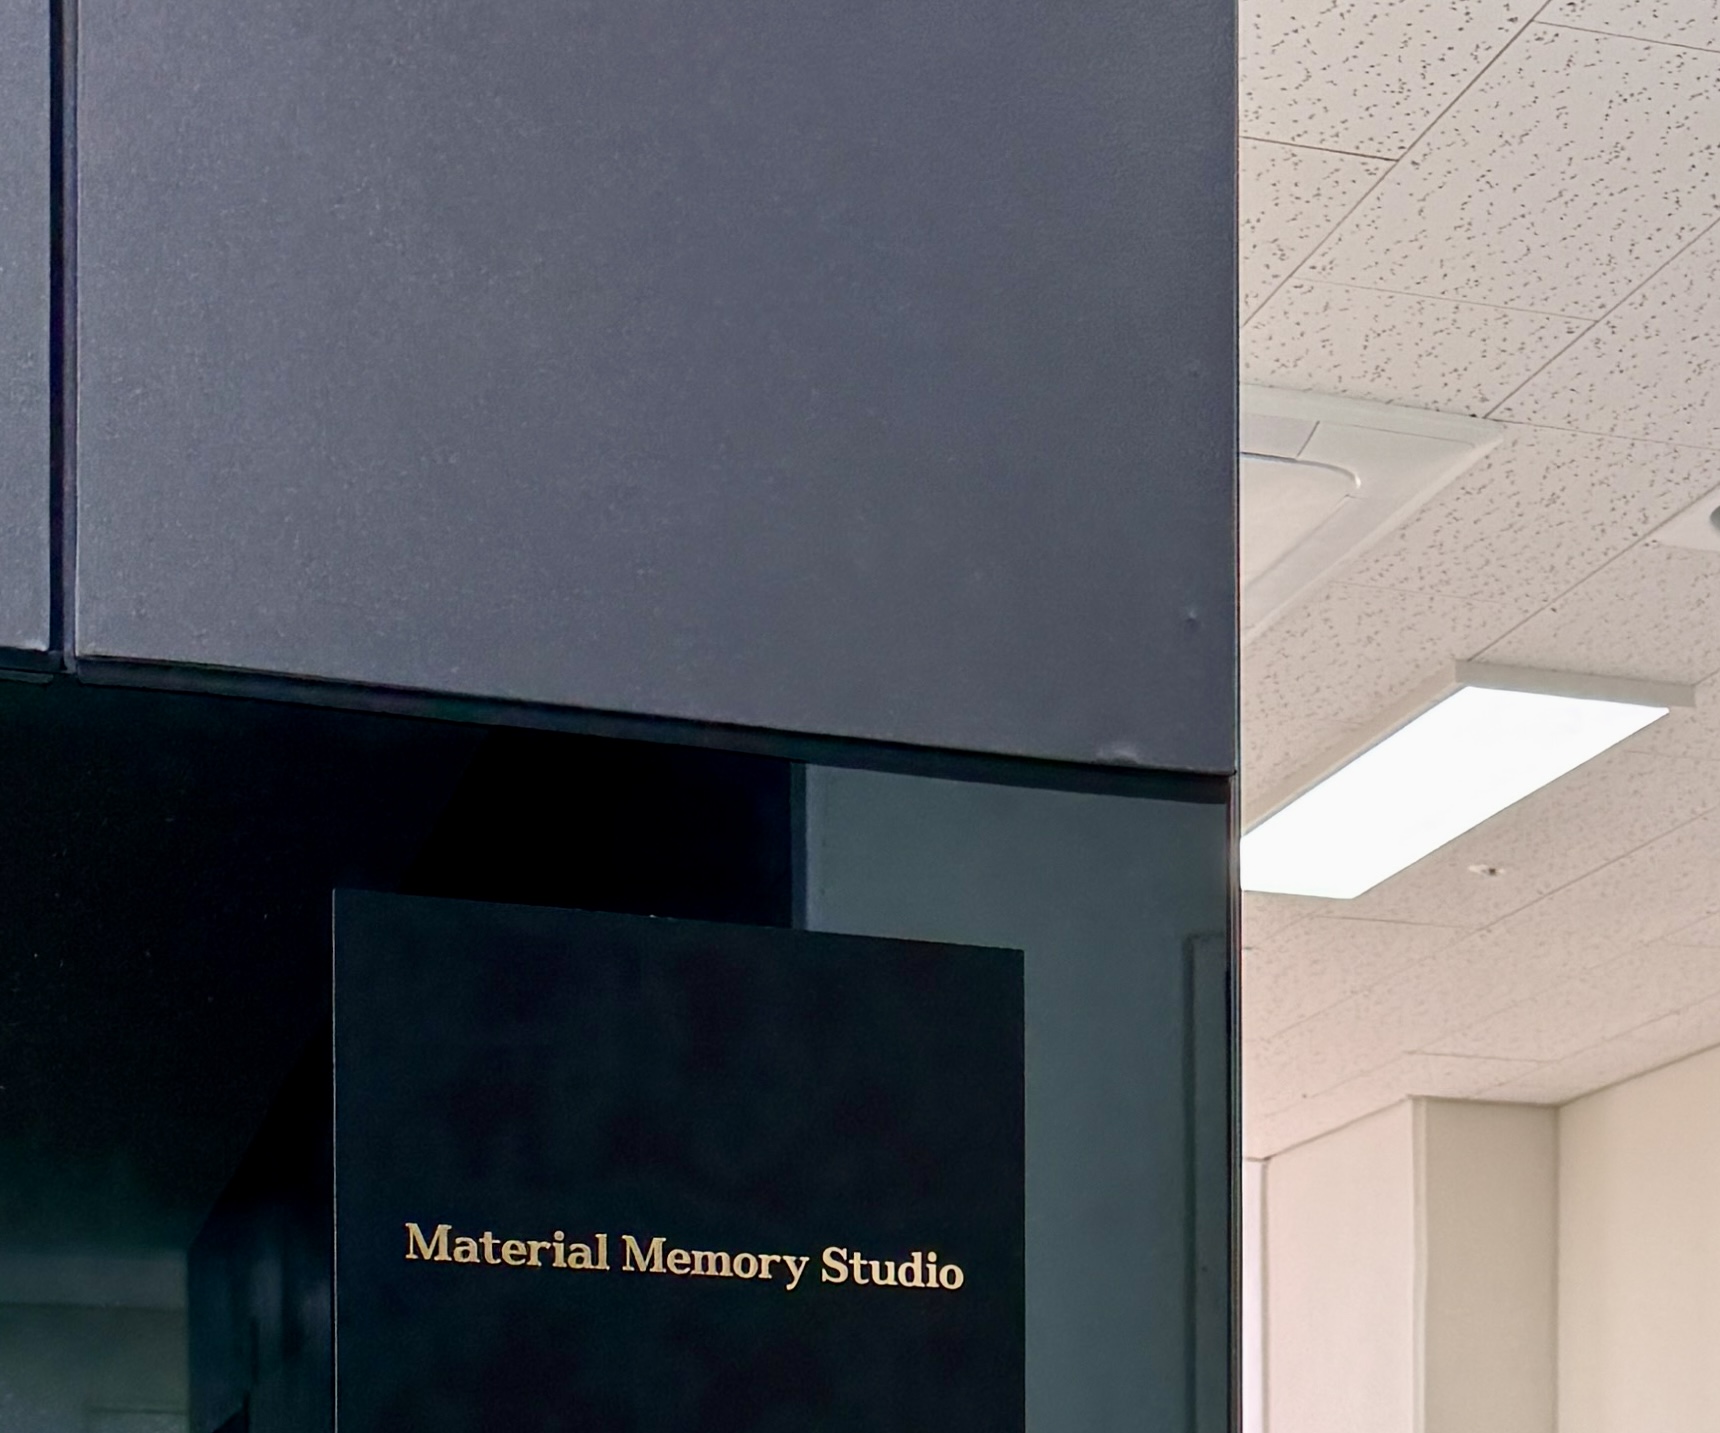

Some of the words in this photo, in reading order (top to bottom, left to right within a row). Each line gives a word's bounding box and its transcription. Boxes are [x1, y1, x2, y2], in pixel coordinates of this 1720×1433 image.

[405, 1222, 610, 1271] Material
[622, 1235, 809, 1290] Memory
[821, 1246, 964, 1289] Studio
